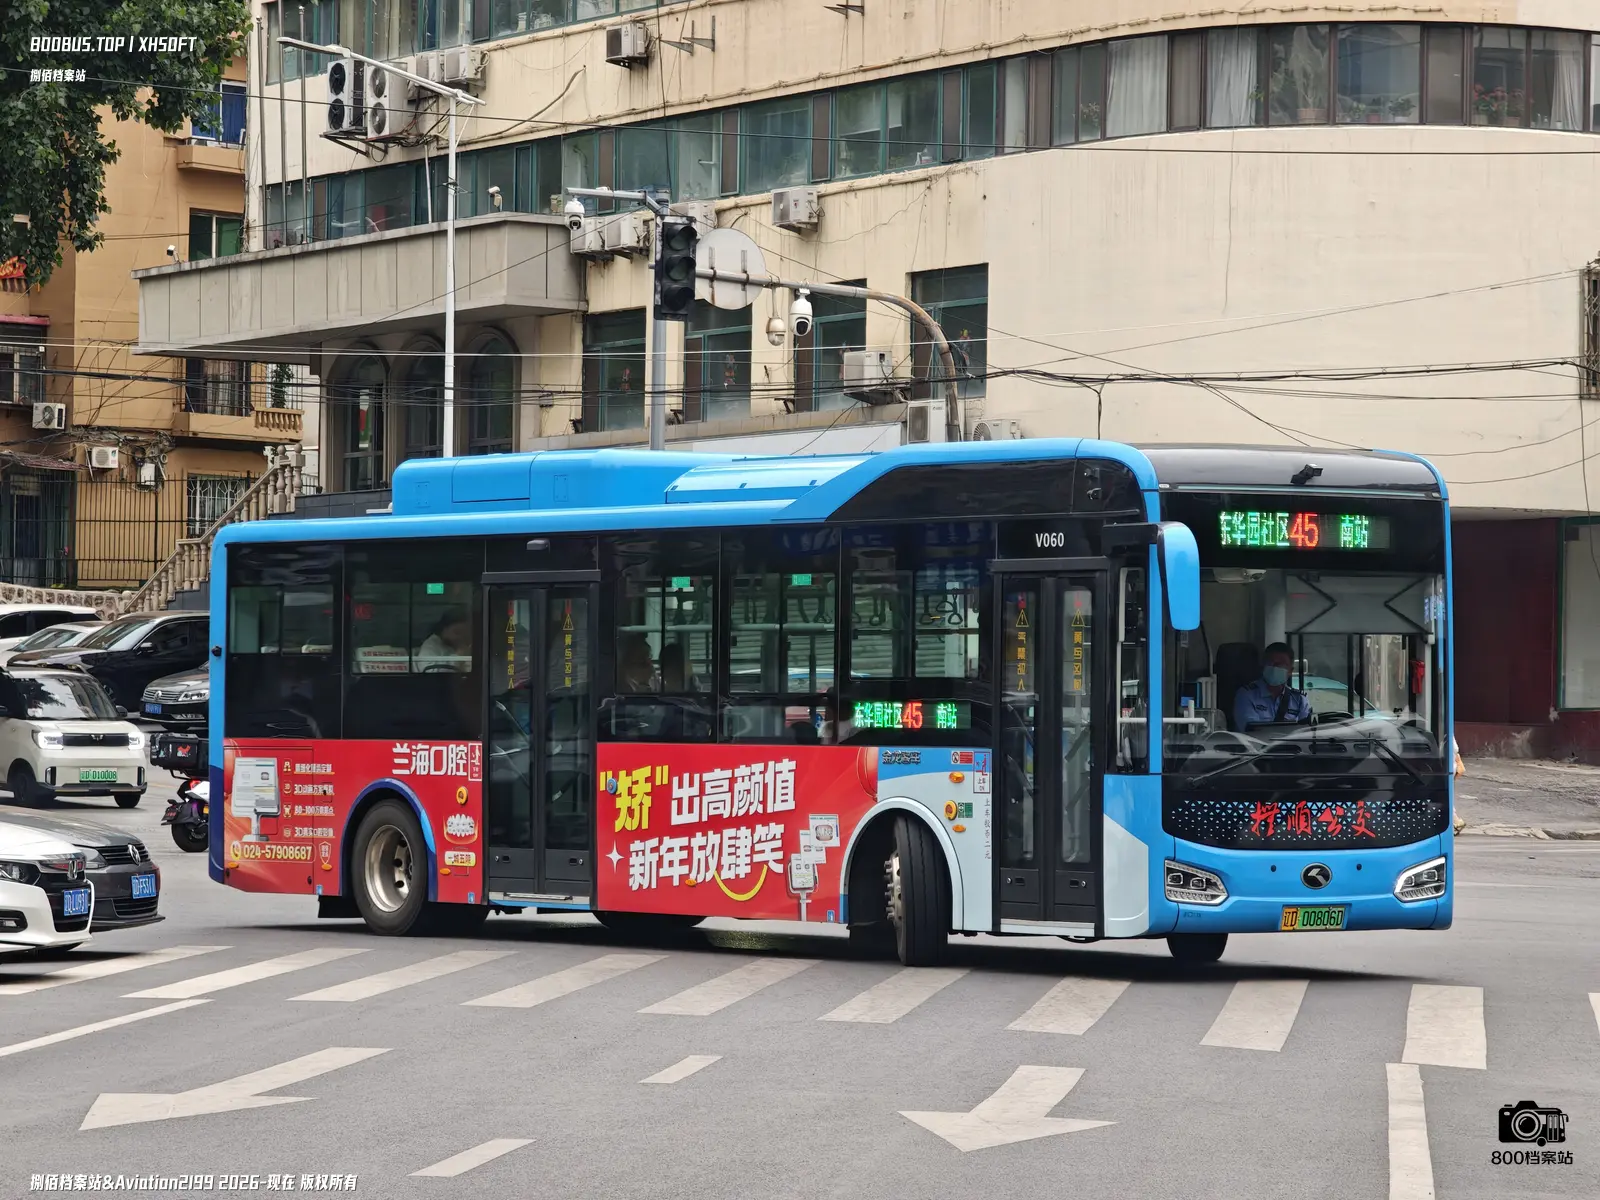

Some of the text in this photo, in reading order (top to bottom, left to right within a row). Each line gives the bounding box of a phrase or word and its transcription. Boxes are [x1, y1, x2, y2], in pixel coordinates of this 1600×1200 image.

[1035, 532, 1065, 548] V060
[1290, 512, 1319, 548] 45
[1339, 514, 1369, 548] 南站
[903, 702, 923, 729] 45
[937, 702, 957, 729] 南站
[392, 742, 467, 776] 兰海口腔
[243, 844, 312, 860] 024-57908687
[629, 822, 785, 891] 新年放肆笑
